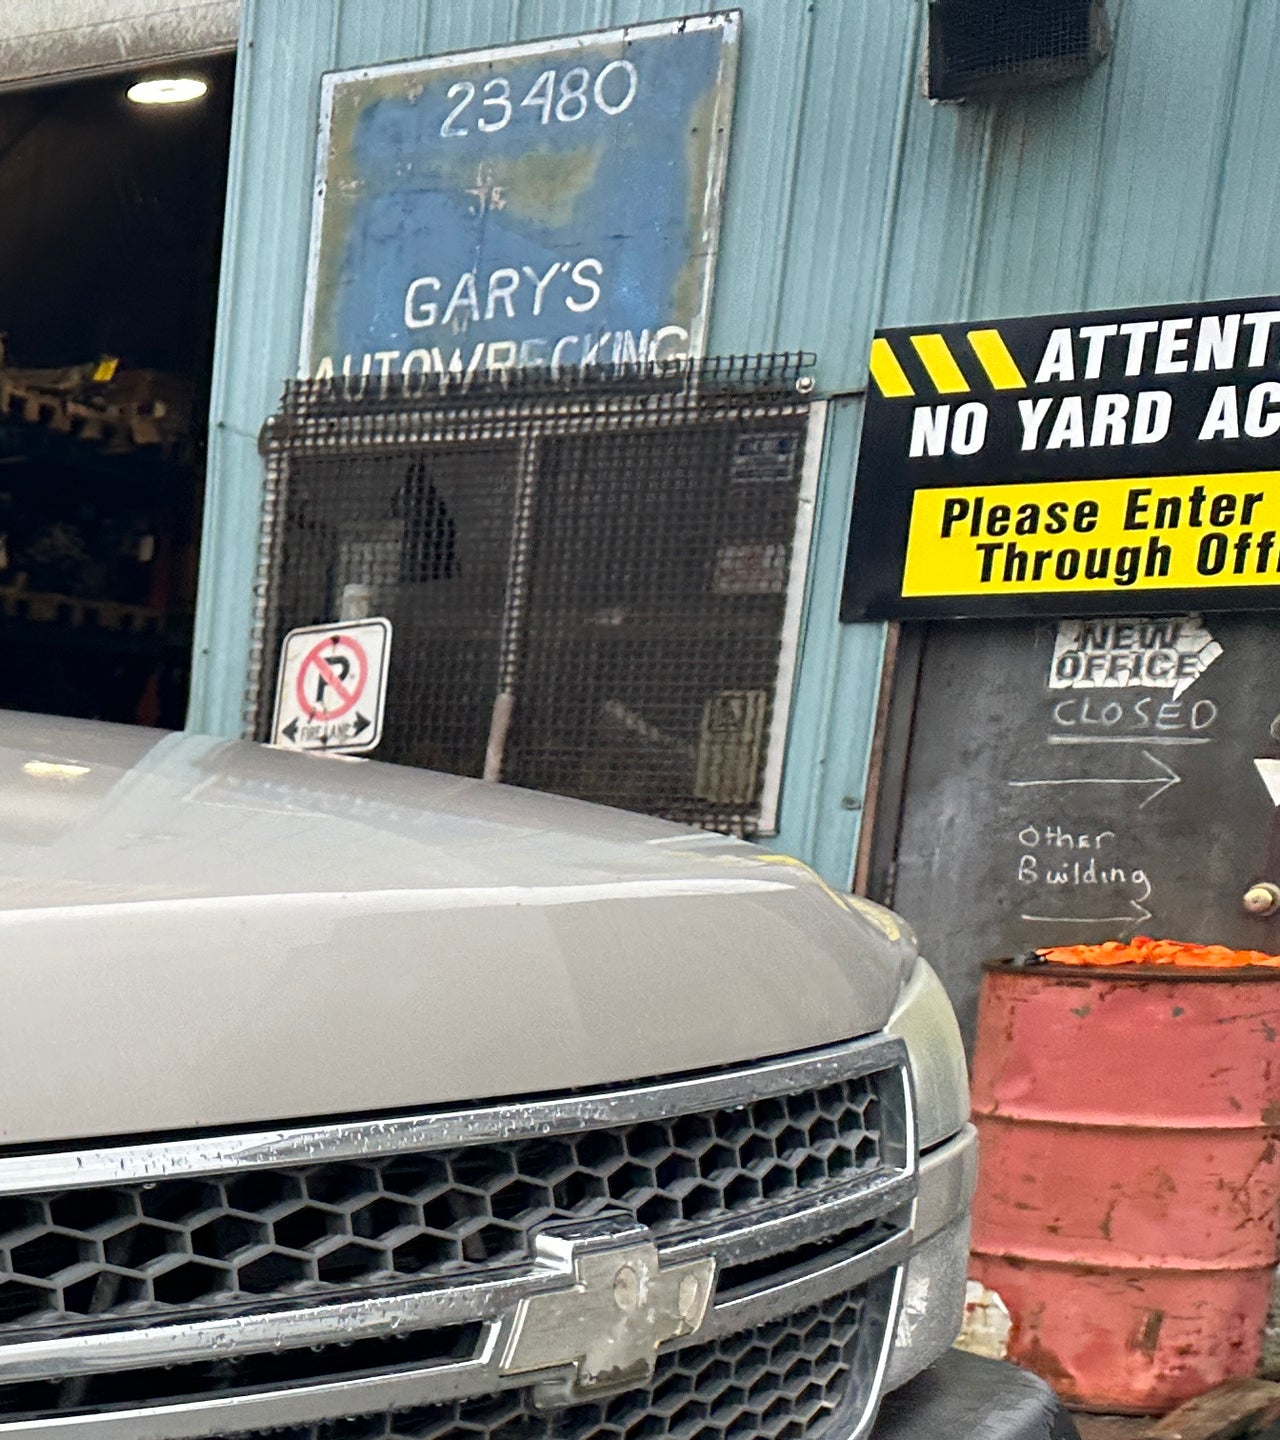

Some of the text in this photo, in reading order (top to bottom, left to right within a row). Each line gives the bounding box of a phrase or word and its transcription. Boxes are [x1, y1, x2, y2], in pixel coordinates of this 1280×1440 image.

[440, 59, 638, 137] 23480
[404, 257, 603, 328] GARY'S
[909, 401, 989, 457] NO
[1017, 390, 1172, 451] YARD
[940, 486, 1264, 539] Please Enter
[976, 530, 1280, 586] Through Off
[1081, 620, 1179, 651] NEW
[1056, 650, 1202, 682] OFFICE
[1053, 697, 1218, 730] CLOSED
[1018, 854, 1152, 902] Building
